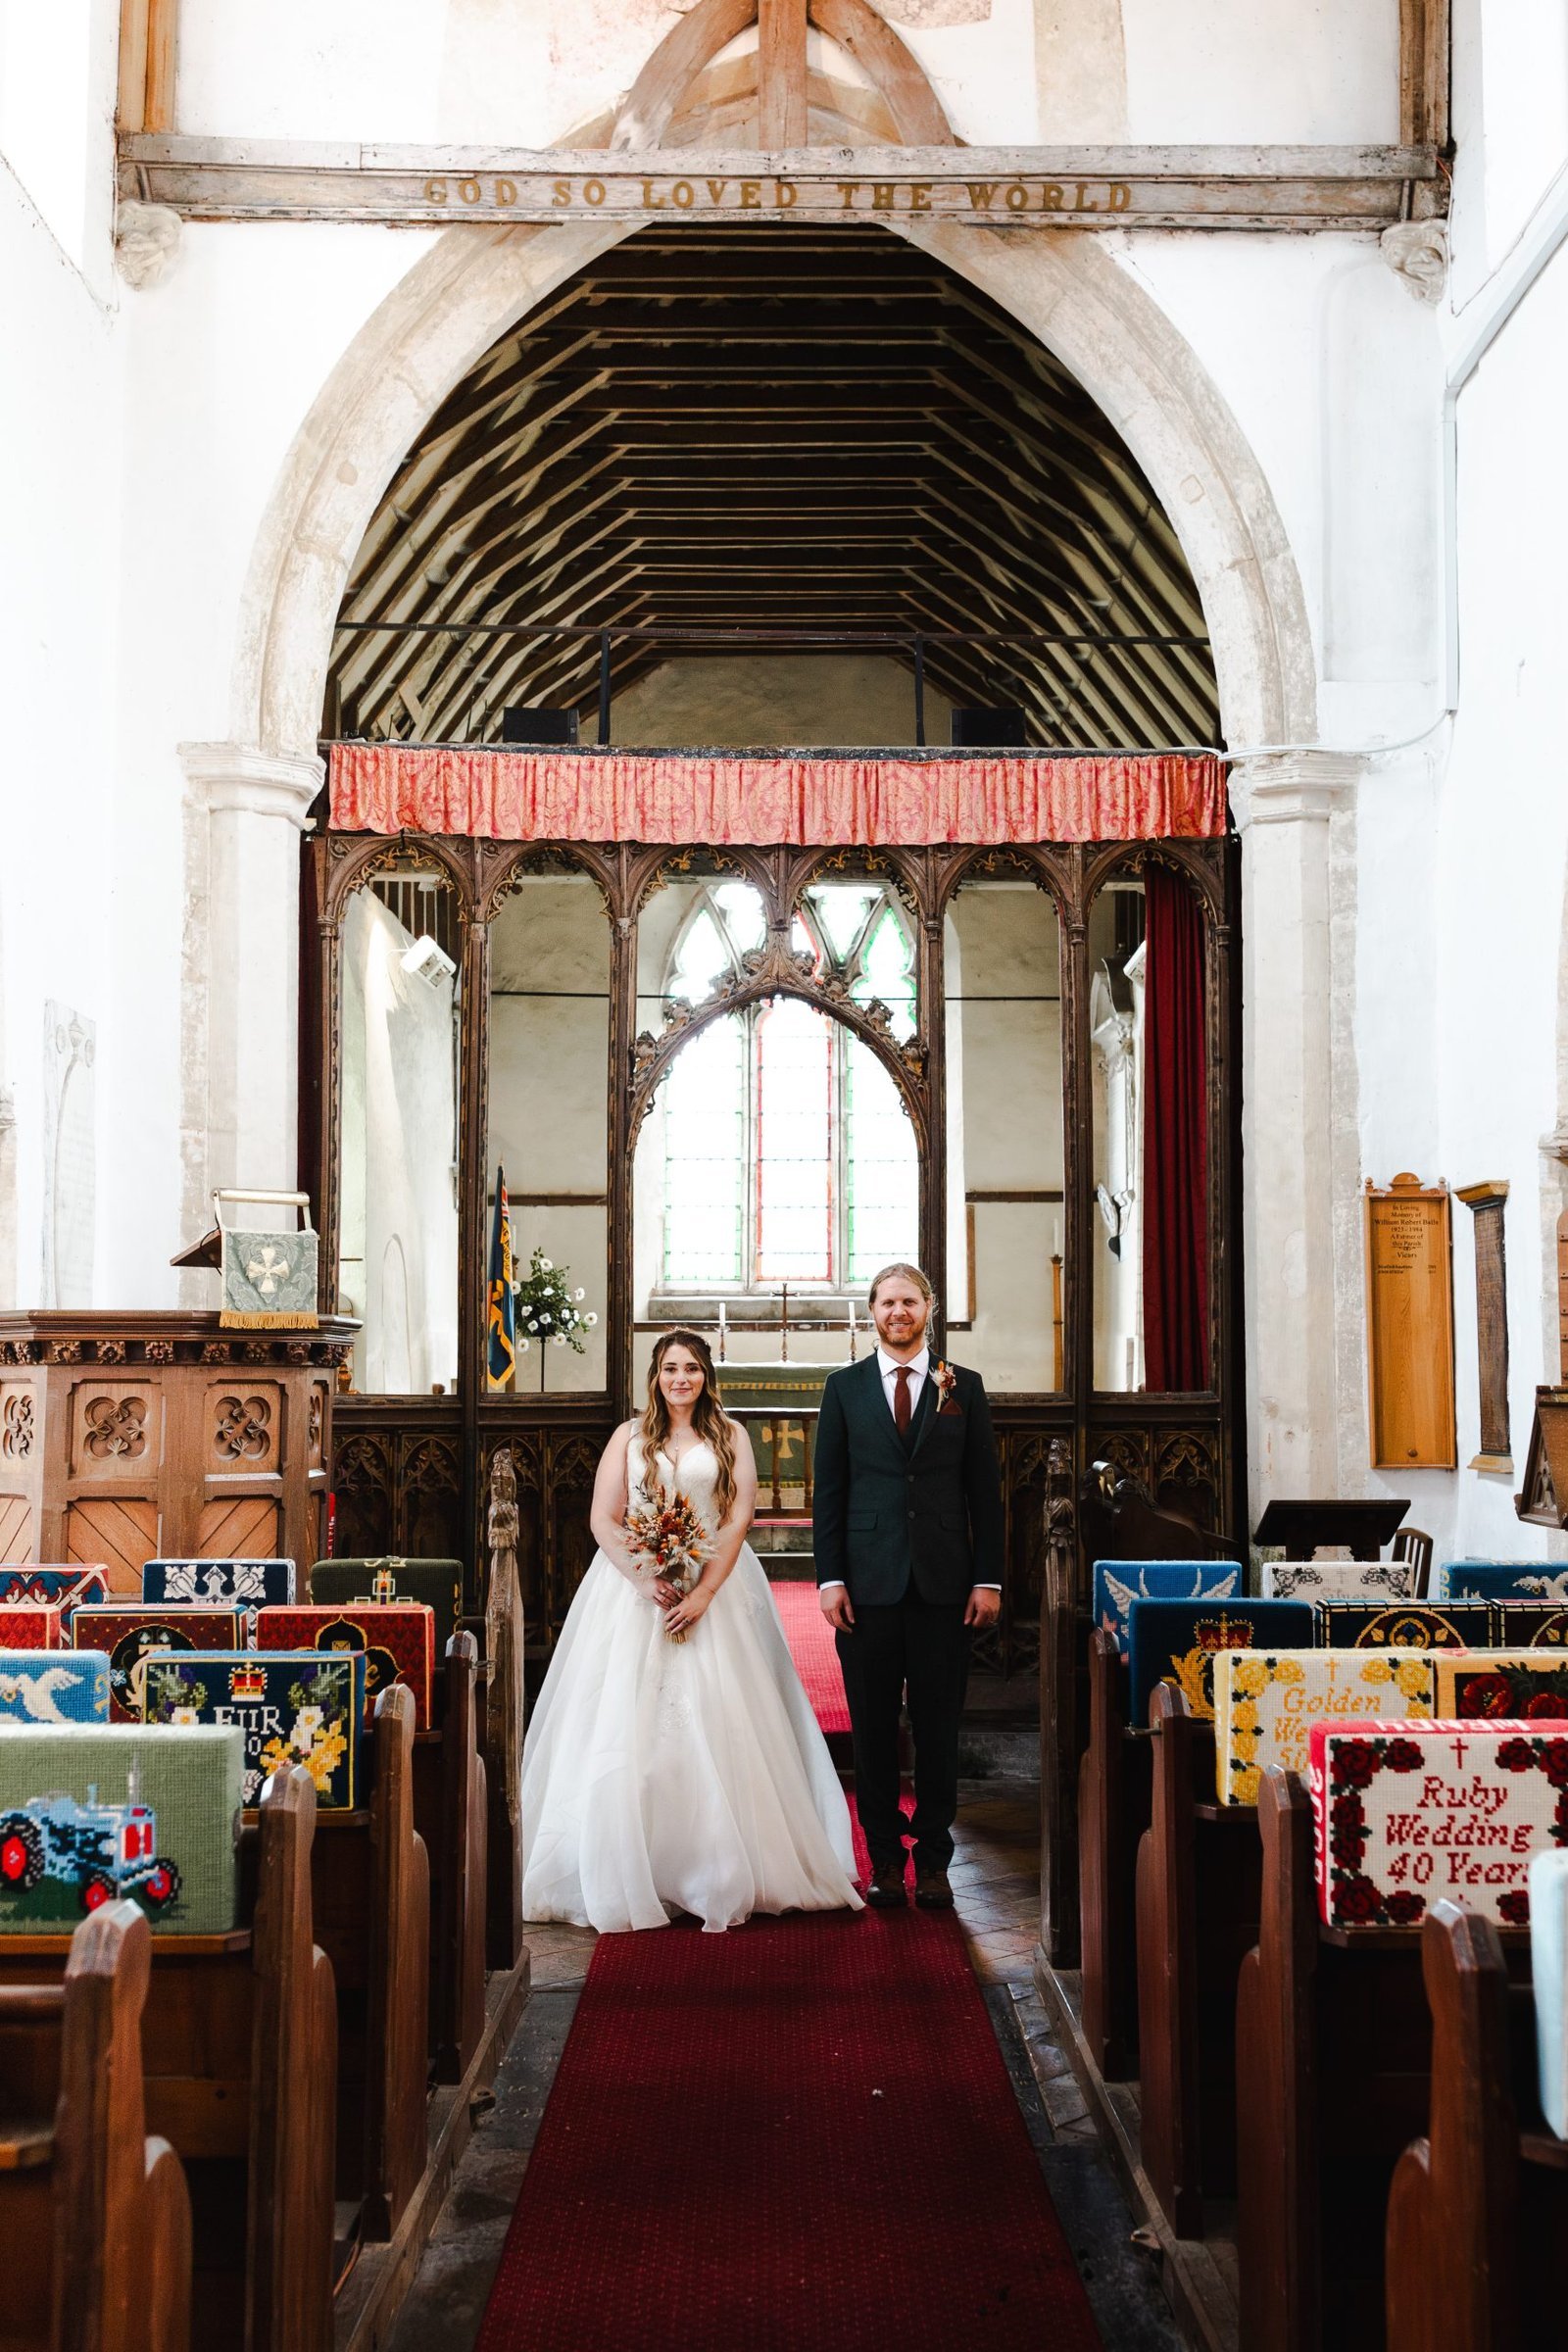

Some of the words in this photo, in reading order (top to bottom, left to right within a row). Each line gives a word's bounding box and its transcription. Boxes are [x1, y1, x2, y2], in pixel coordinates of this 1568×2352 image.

[423, 178, 516, 207] GOD
[552, 179, 606, 208] SO
[641, 180, 798, 210] LOVED
[837, 182, 932, 211] THE
[965, 182, 1132, 212] WORLD
[1284, 1686, 1380, 1713] Golden
[1416, 1776, 1508, 1815] Ruby
[1386, 1814, 1534, 1853] Wedding
[1388, 1852, 1434, 1884] 40
[1446, 1852, 1529, 1884] Year
